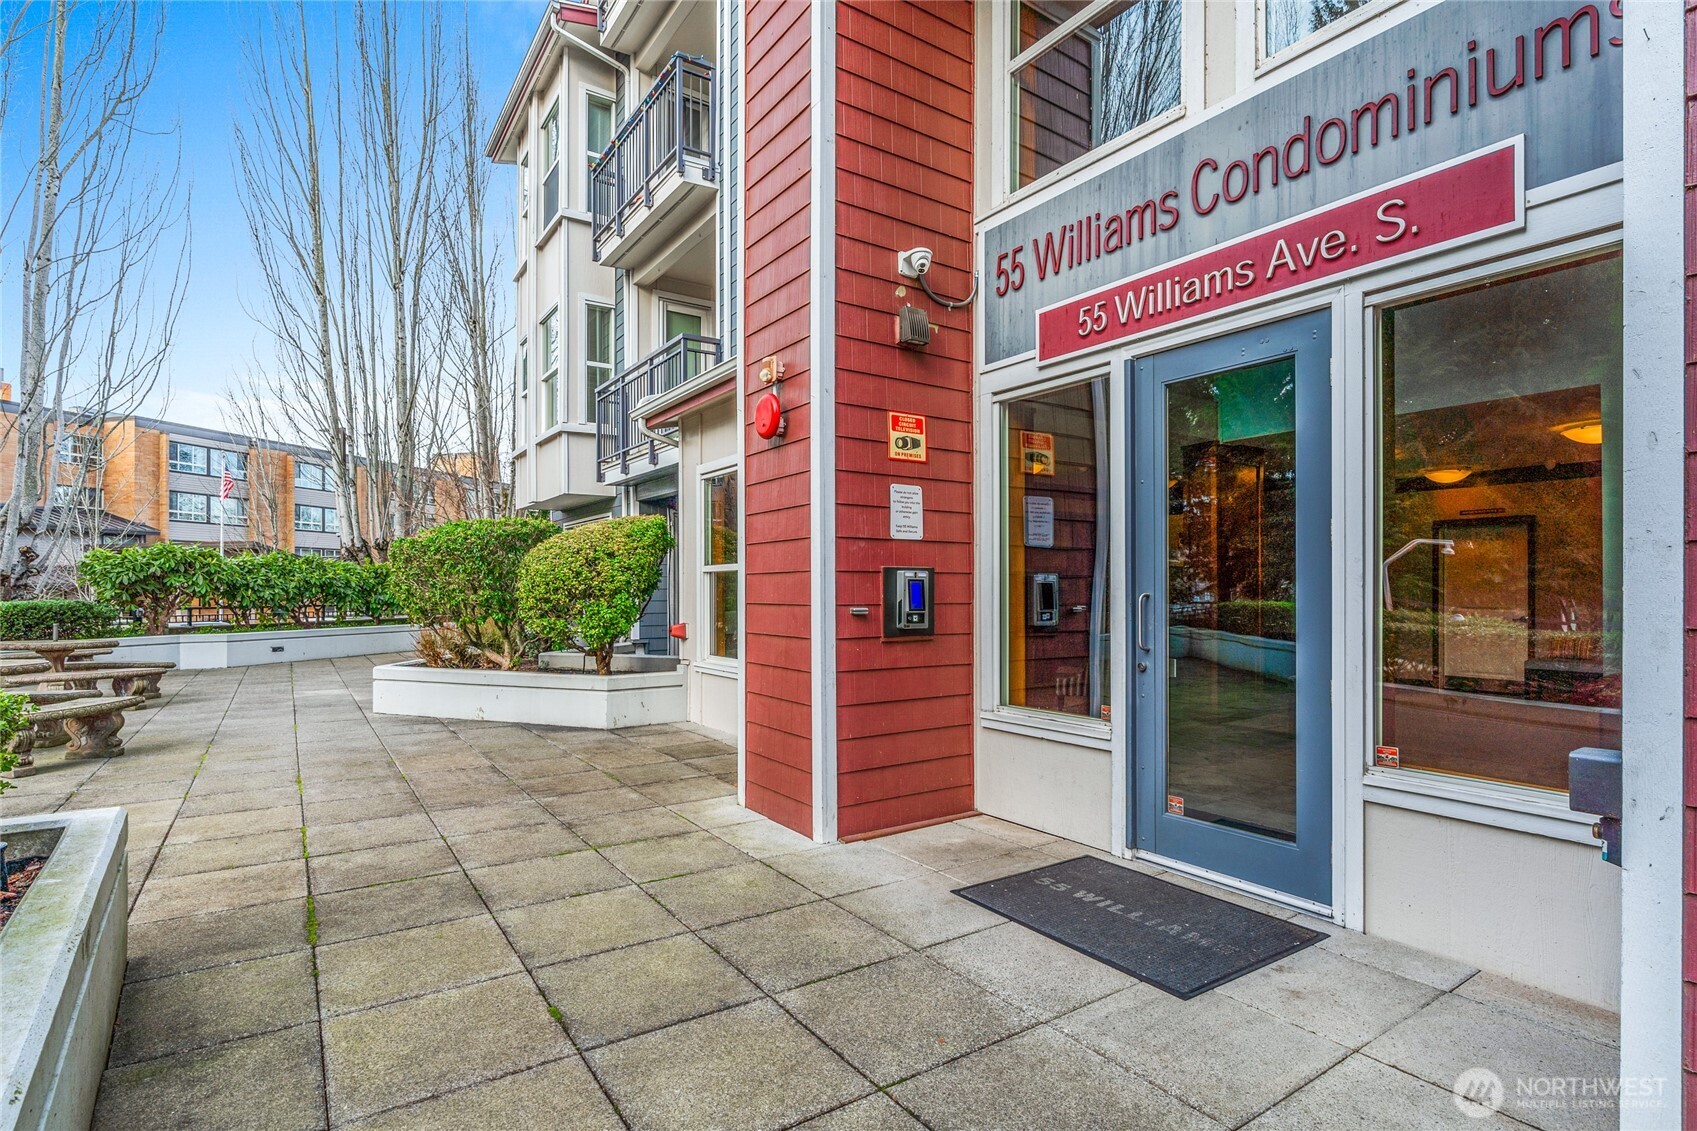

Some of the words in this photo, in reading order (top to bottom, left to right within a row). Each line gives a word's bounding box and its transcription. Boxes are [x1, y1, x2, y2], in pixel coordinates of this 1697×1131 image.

[996, 245, 1025, 297] 55
[1032, 190, 1179, 281] Williams
[1078, 300, 1108, 336] 55
[1114, 260, 1256, 325] Williams
[1266, 229, 1358, 280] Ave.
[1375, 198, 1419, 243] S.
[895, 425, 921, 434] TELEVISION
[1034, 876, 1072, 893] 55
